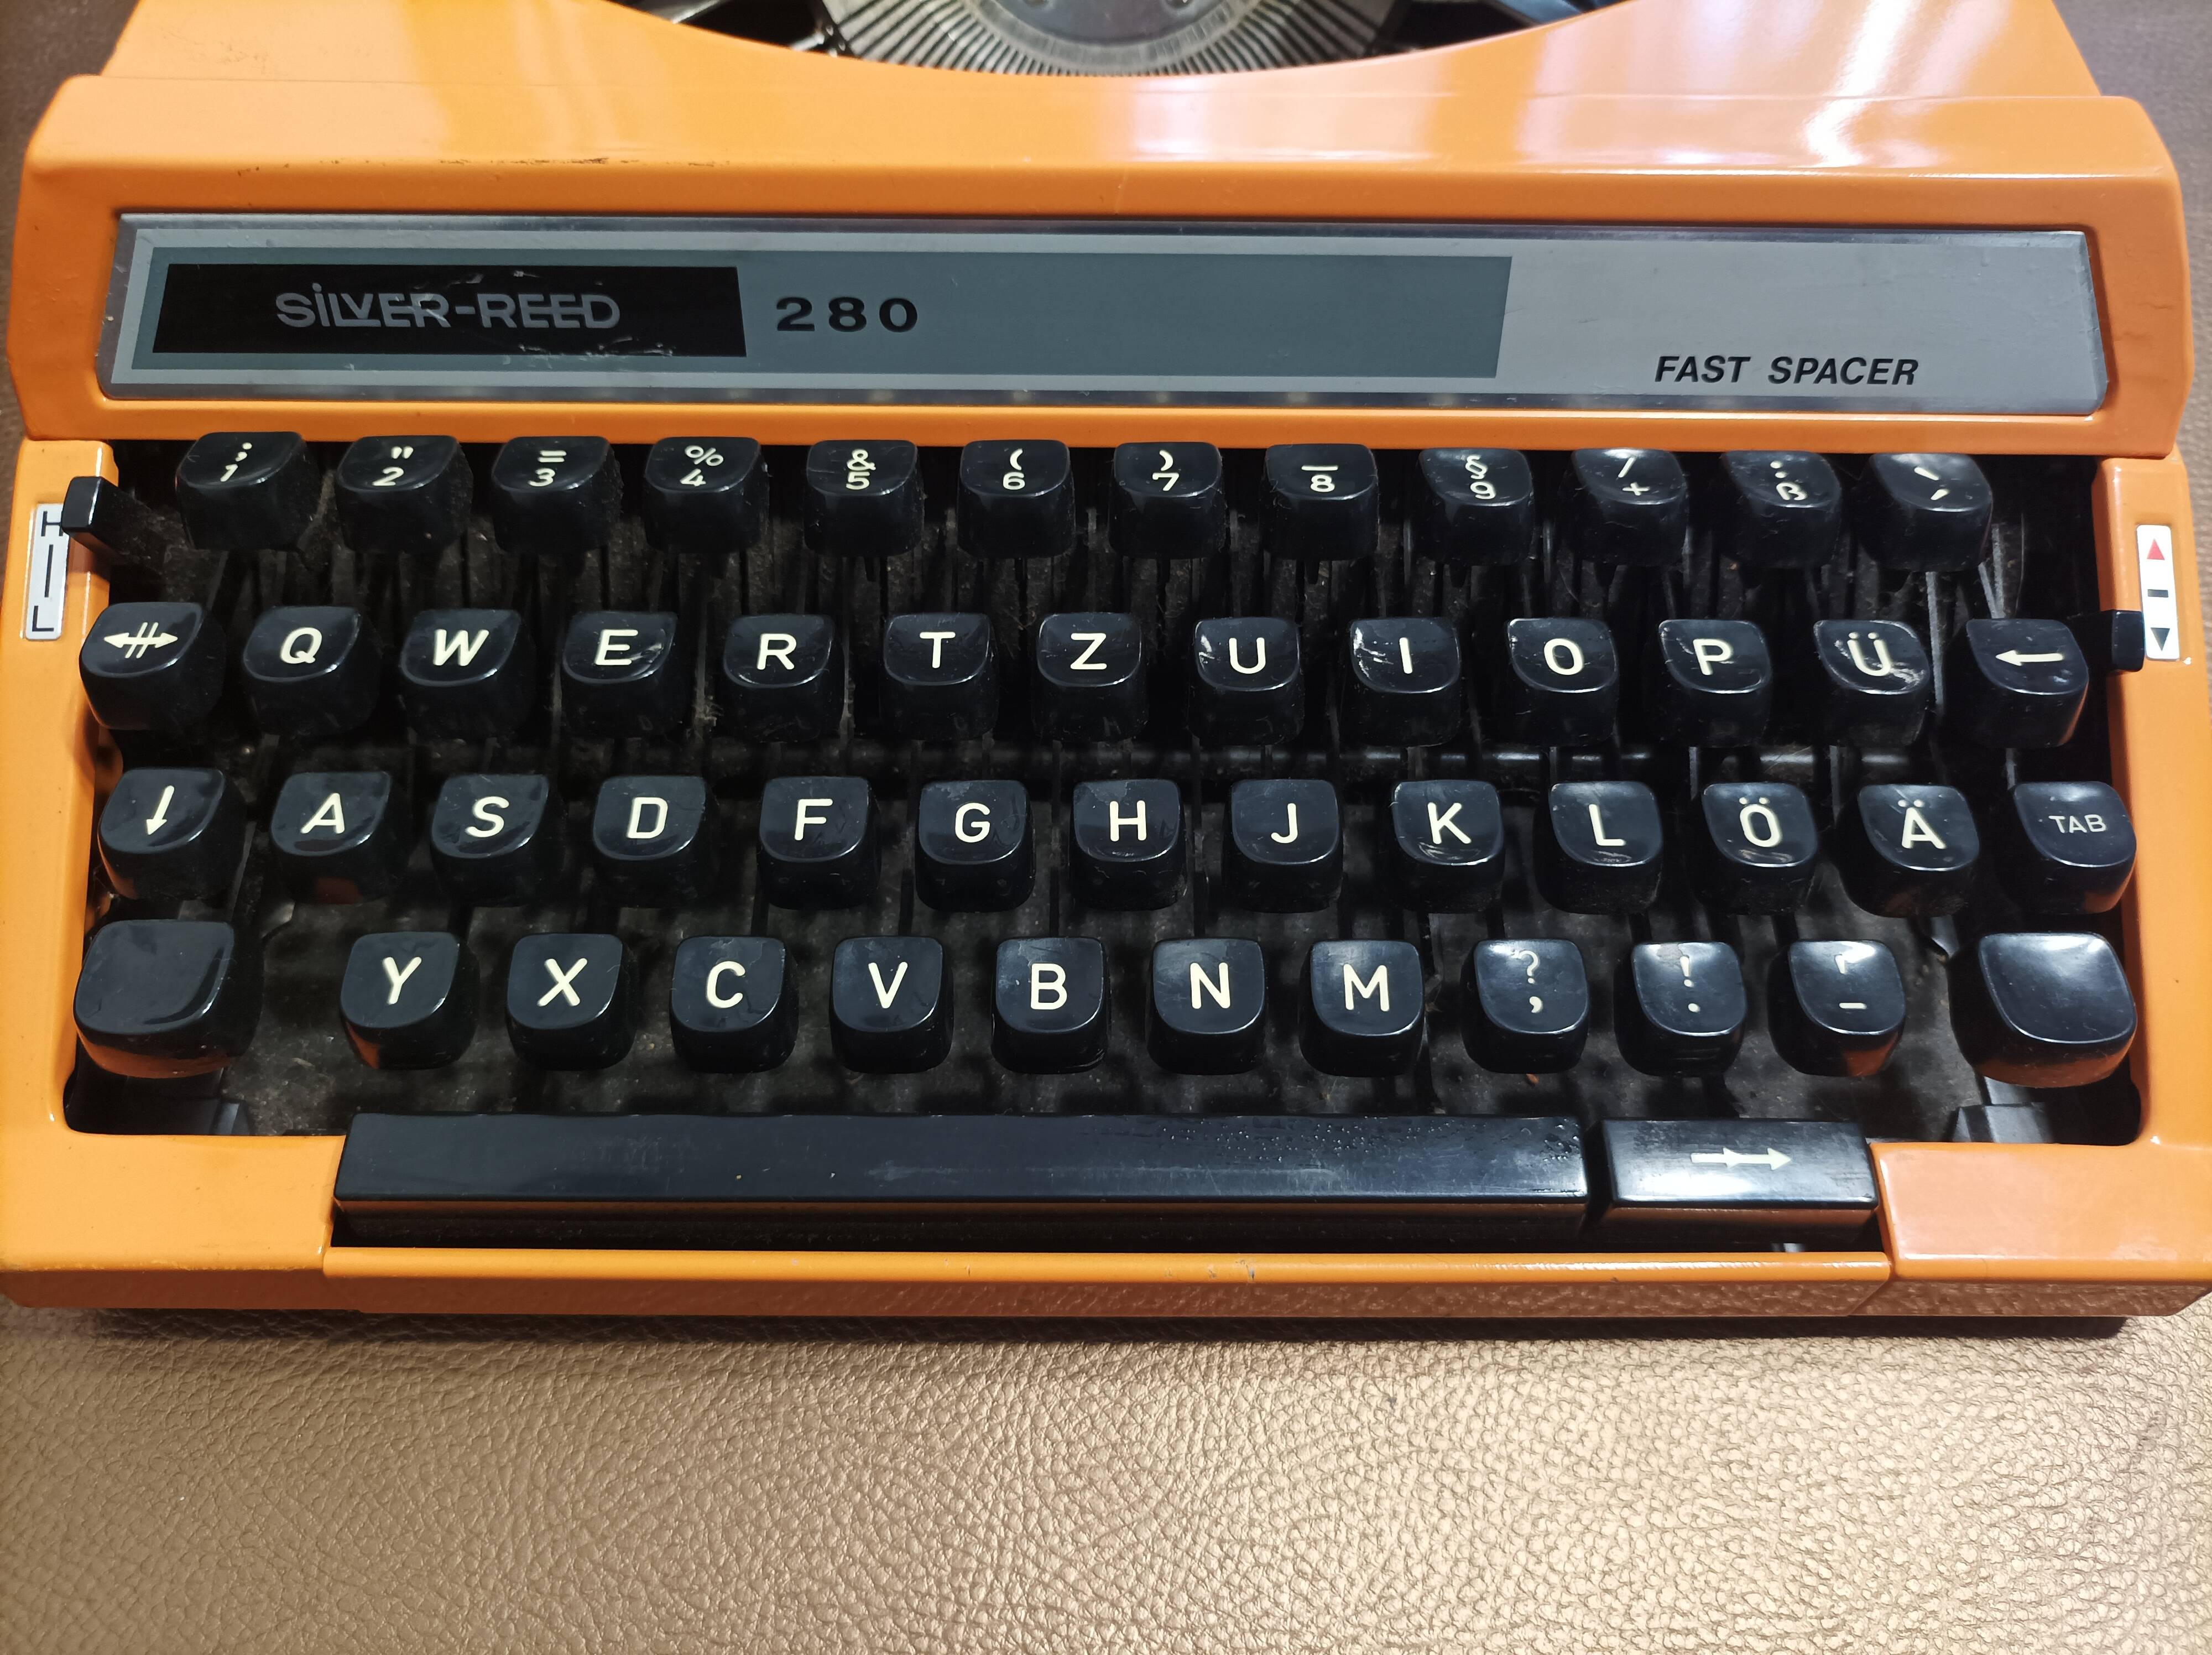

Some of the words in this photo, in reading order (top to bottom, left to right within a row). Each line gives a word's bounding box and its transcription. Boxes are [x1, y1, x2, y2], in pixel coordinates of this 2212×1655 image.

[776, 296, 919, 333] 280
[1655, 355, 1751, 383] FAST
[1768, 356, 1919, 386] SPACER
[221, 464, 238, 481] 1
[538, 450, 567, 462] =
[685, 446, 723, 466] %
[847, 449, 875, 471] &
[1009, 449, 1023, 471] (
[1159, 449, 1173, 471] )
[1465, 455, 1488, 479] §
[1618, 457, 1635, 478] /
[1770, 461, 1787, 478] :
[372, 467, 404, 486] 2
[529, 469, 556, 486] 3
[680, 469, 706, 486] 4
[846, 471, 870, 490] 5
[1003, 472, 1025, 490] 6
[1152, 472, 1179, 491] 7
[1310, 475, 1335, 492] 8
[1470, 481, 1495, 499] 9
[1623, 483, 1650, 496] +
[41, 511, 64, 537] H
[31, 606, 54, 632] L
[280, 627, 322, 664] Q
[433, 629, 489, 666] W
[595, 629, 638, 665] E
[757, 633, 797, 670] R
[919, 632, 956, 668] T
[1070, 633, 1107, 670] Z
[1229, 637, 1266, 674] U
[1399, 637, 1413, 674] I
[1544, 638, 1584, 675] O
[1693, 639, 1734, 675] P
[1846, 632, 1892, 676] Ü
[300, 793, 345, 834] A
[465, 797, 510, 837] S
[627, 797, 668, 839] D
[794, 799, 833, 841] F
[955, 803, 990, 842] G
[1109, 800, 1147, 841] H
[1271, 803, 1298, 844] J
[1428, 803, 1472, 844] K
[1589, 804, 1626, 846] L
[1739, 797, 1783, 847] Ö
[1897, 799, 1946, 850] Ä
[2048, 814, 2106, 833] TAB
[382, 957, 422, 1005] Y
[537, 958, 588, 1007] X
[706, 961, 745, 1008] C
[868, 962, 908, 1009] V
[1190, 962, 1231, 1009] N
[1517, 950, 1540, 985] ?
[1679, 955, 1694, 988] !
[1030, 964, 1067, 1010] B
[1343, 964, 1390, 1012] M
